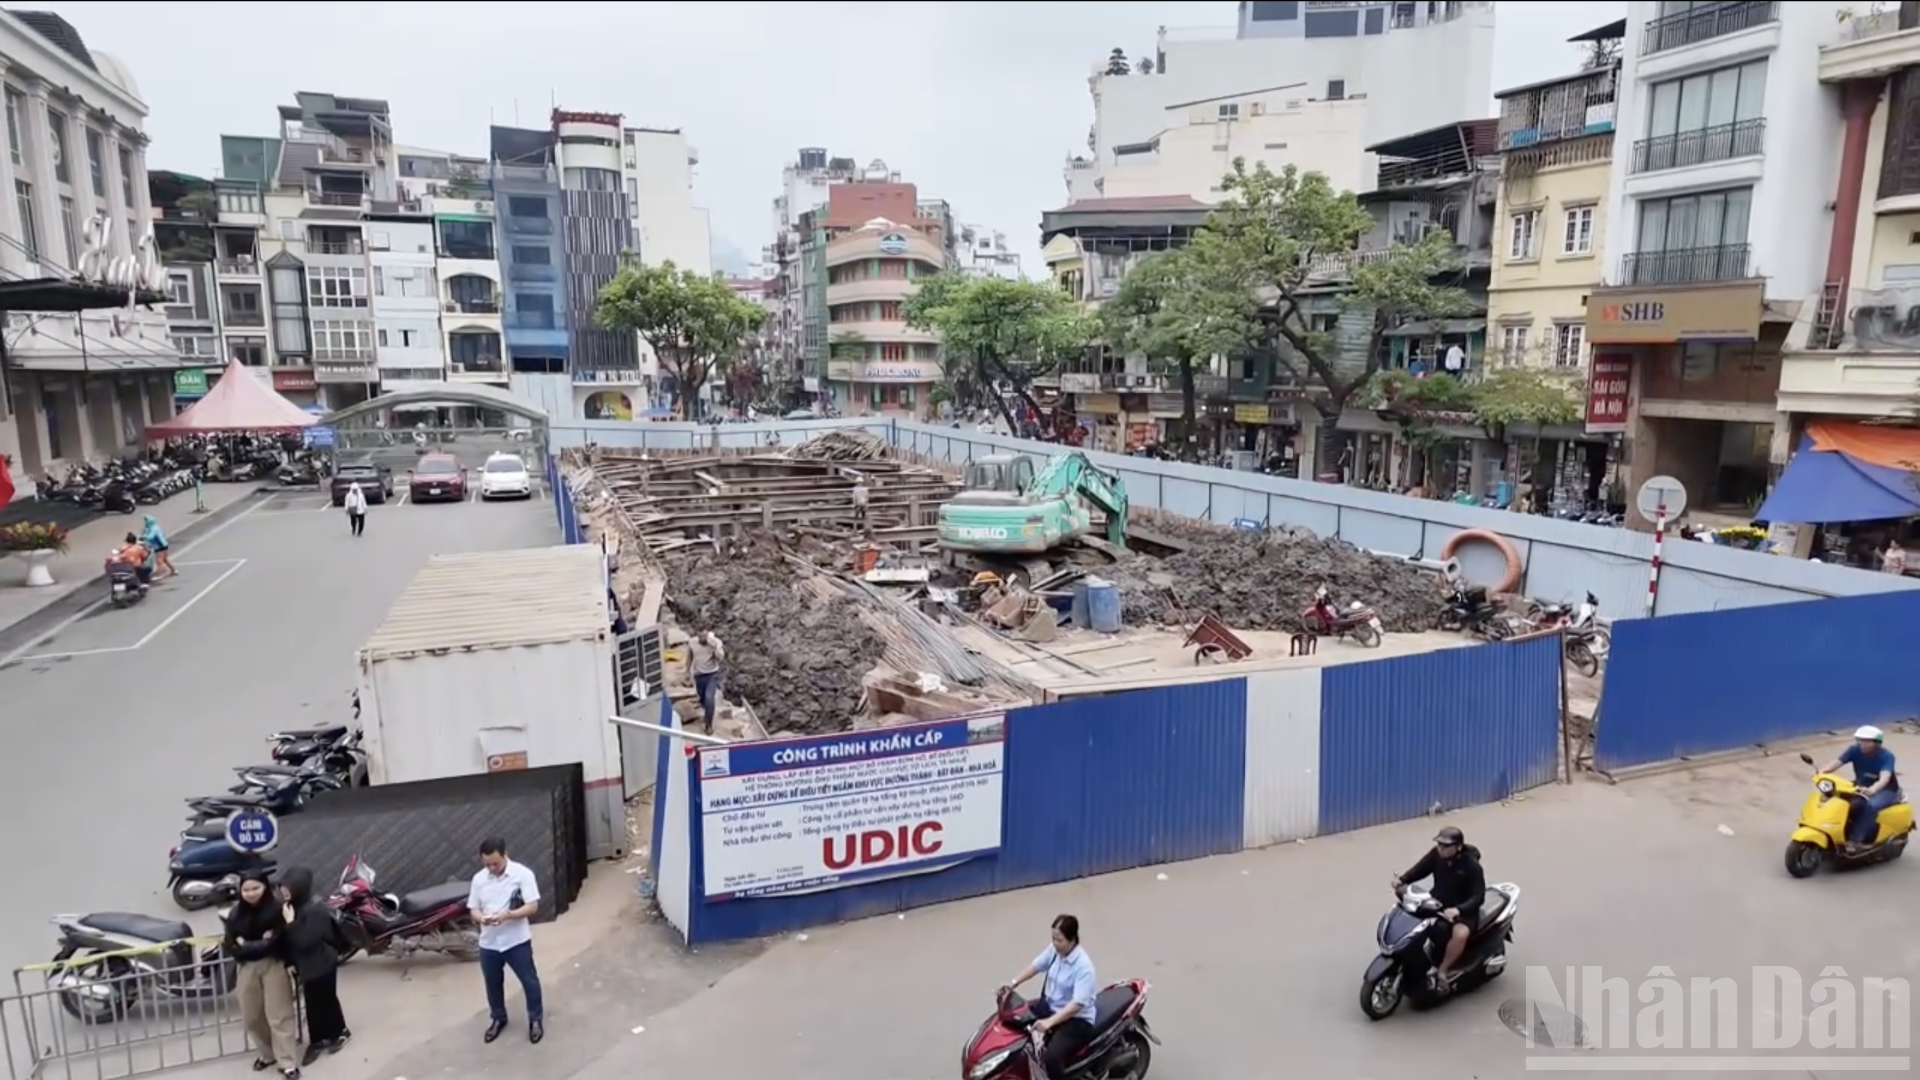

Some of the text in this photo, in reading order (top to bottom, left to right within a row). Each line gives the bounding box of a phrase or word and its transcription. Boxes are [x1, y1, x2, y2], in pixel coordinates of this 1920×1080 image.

[1621, 302, 1665, 322] SHB
[773, 748, 816, 764] CÔNG
[820, 740, 866, 758] TRÌNH
[914, 729, 943, 746] CẤP
[823, 820, 943, 871] UDIC
